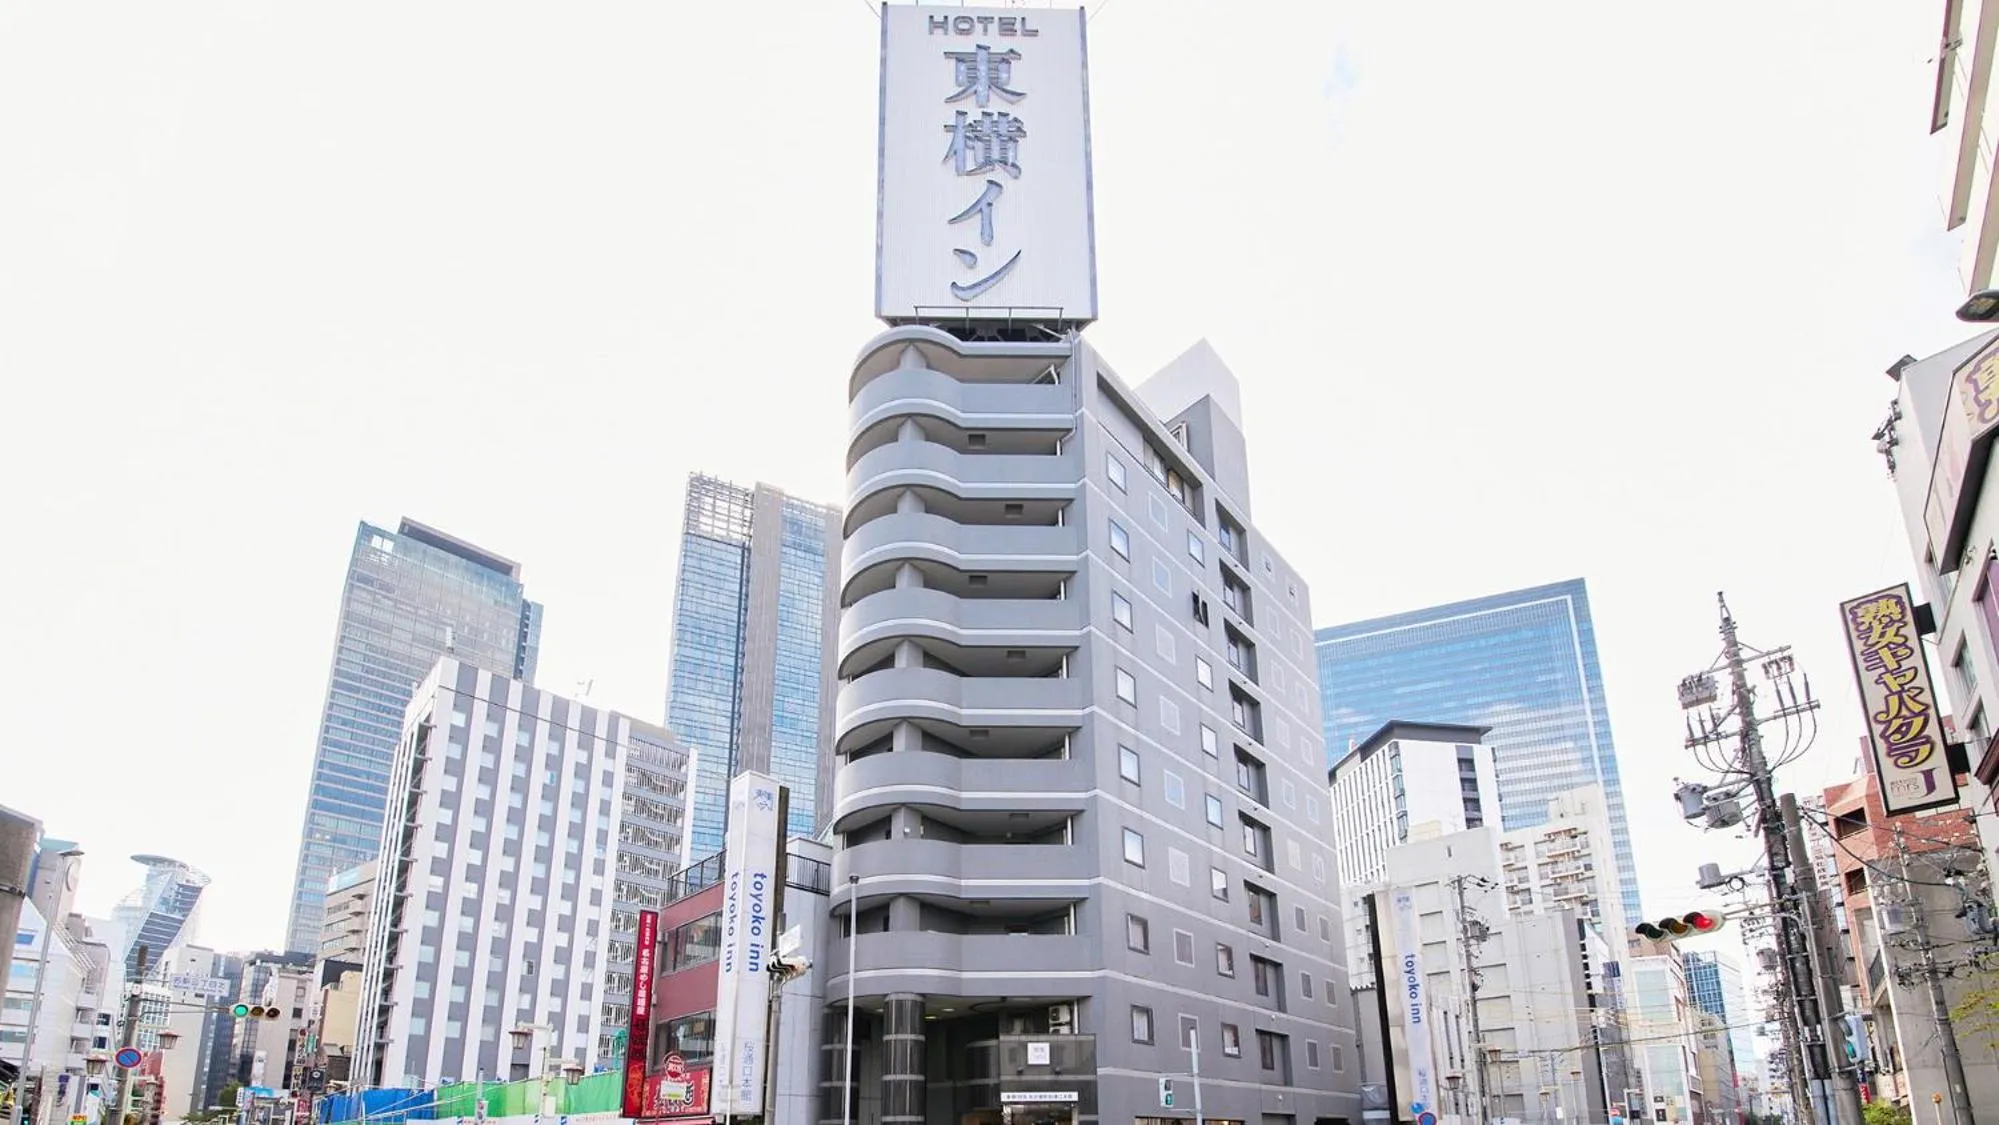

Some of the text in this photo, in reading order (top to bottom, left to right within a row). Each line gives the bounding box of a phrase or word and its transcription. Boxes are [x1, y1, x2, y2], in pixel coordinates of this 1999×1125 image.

[928, 15, 1039, 37] HOTEL
[942, 44, 1028, 302] 東横イン
[725, 872, 740, 973] toyoko inn
[748, 872, 768, 973] toyoko inn
[1404, 953, 1423, 1024] toyoko inn
